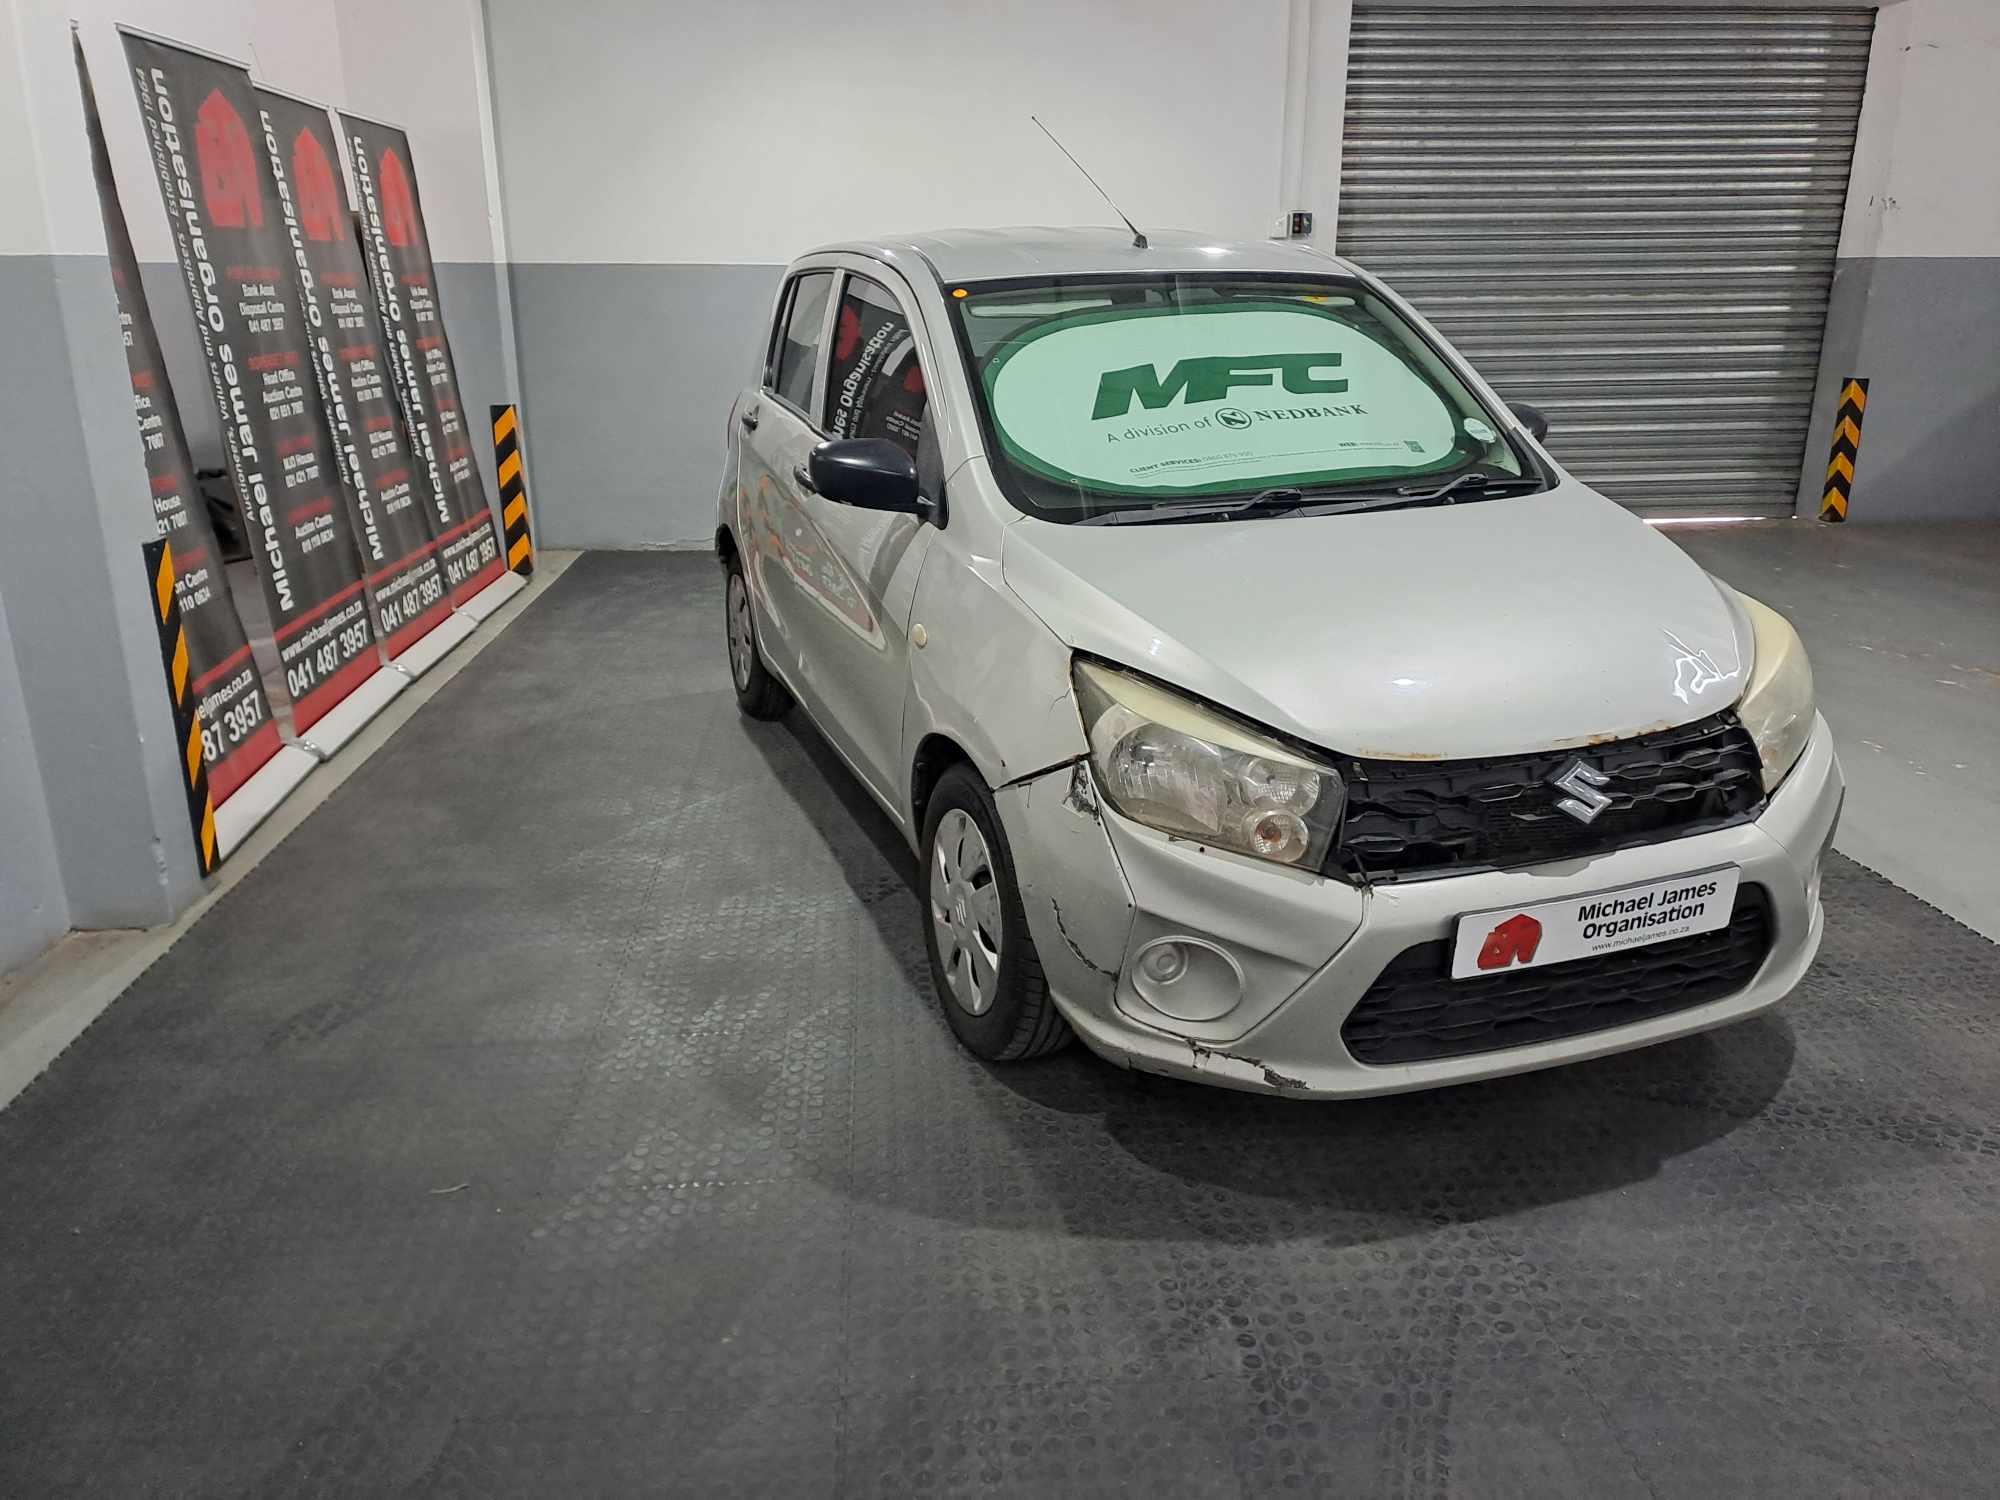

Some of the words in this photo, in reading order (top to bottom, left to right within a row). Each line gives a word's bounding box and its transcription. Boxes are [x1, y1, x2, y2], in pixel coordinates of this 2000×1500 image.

[135, 67, 153, 111] 1964
[147, 116, 179, 217] Established
[151, 68, 224, 333] Organisation
[259, 110, 322, 328] Organisation
[353, 136, 401, 322] Organisation
[177, 232, 205, 321] Appraisers
[199, 323, 213, 357] and
[396, 329, 424, 415] James
[210, 361, 229, 420] Valuers
[219, 344, 258, 463] James
[317, 336, 351, 436] James
[1091, 352, 1349, 421] MFC
[1106, 432, 1121, 443] A
[1123, 422, 1191, 440] division
[1194, 416, 1213, 430] of
[1253, 404, 1368, 421] NEDBANK
[153, 494, 182, 513] House
[227, 427, 255, 521] Auctioneers,
[343, 444, 384, 560] Michael
[416, 422, 450, 523] Michael
[1129, 464, 1159, 474] CLIENT
[247, 472, 294, 611] Michael
[447, 558, 467, 585] 041
[465, 548, 480, 573] 487
[380, 602, 403, 633] 041
[402, 588, 421, 617] 487
[419, 573, 442, 606] 3957
[287, 657, 315, 697] 041
[316, 639, 338, 675] 487
[339, 618, 368, 658] 3957
[201, 721, 224, 762] 87
[223, 689, 262, 742] 3957
[1577, 892, 1654, 922] Michael
[1657, 881, 1717, 906] James
[1582, 902, 1705, 939] Organisation
[1592, 926, 1690, 951] www.michaeljames.co.za
